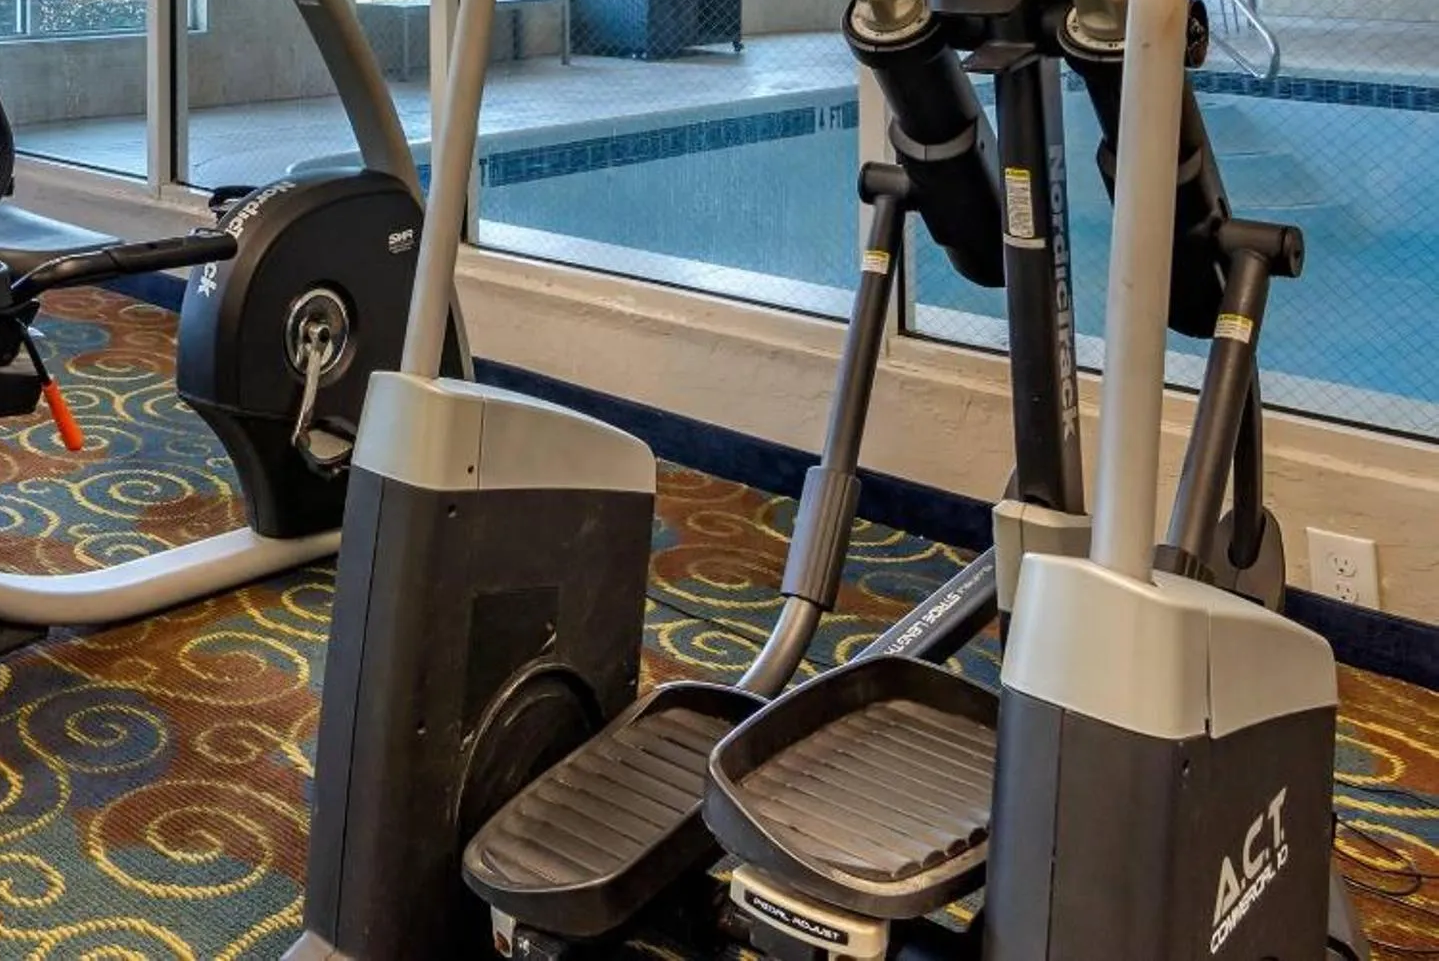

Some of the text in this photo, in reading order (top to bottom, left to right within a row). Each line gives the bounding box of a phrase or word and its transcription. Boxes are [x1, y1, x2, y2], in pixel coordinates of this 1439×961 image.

[197, 180, 297, 298] NordicTck
[1047, 143, 1078, 442] NordicTrack
[790, 916, 841, 942] ADJUST
[1210, 842, 1290, 956] COMMERCIAL 10
